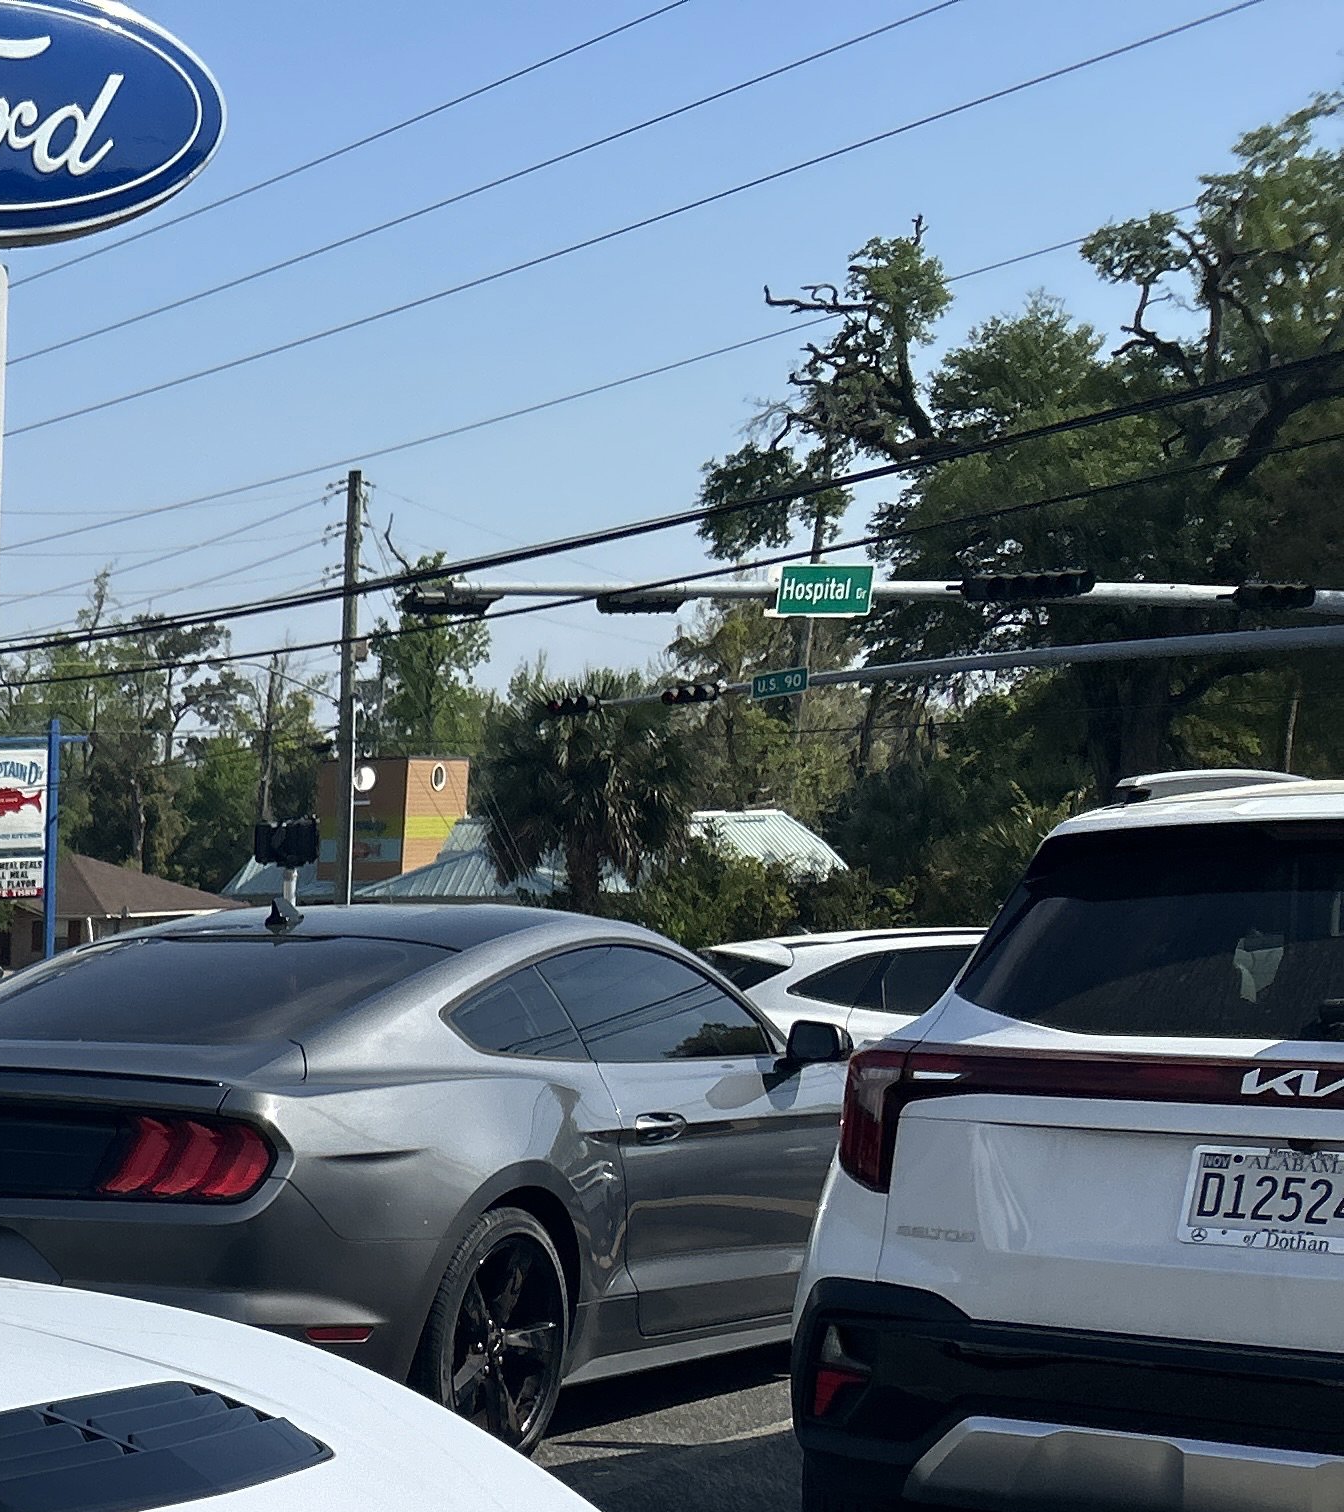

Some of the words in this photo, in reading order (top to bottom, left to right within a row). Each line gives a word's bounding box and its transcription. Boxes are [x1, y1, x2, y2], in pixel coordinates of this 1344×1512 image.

[782, 577, 853, 605] Hospital
[855, 587, 867, 599] Dr
[784, 674, 802, 688] 90
[19, 860, 43, 869] DEALS
[9, 870, 29, 879] MEAL
[7, 879, 36, 889] FLAVOR
[1203, 1155, 1230, 1169] NOV
[1248, 1155, 1344, 1174] ALABAM
[1242, 1231, 1260, 1246] of
[1265, 1231, 1331, 1252] Dothan
